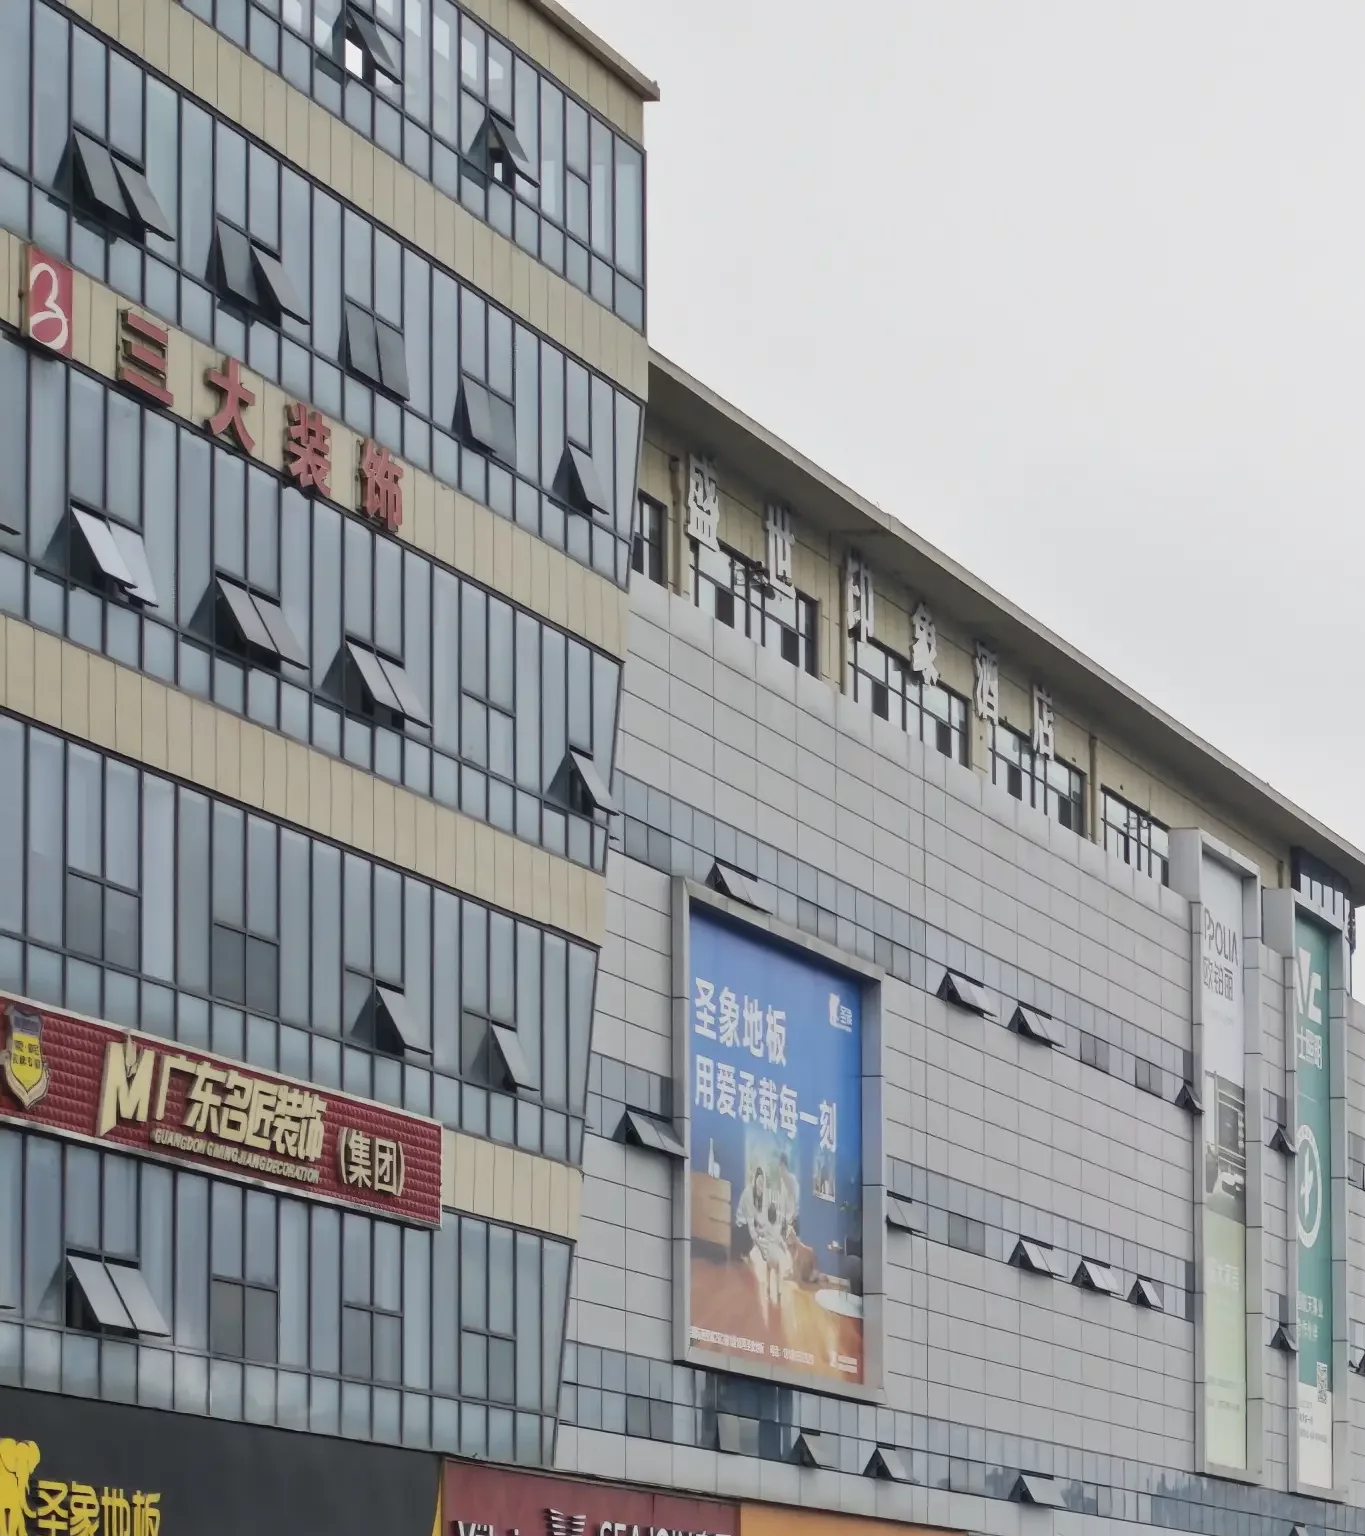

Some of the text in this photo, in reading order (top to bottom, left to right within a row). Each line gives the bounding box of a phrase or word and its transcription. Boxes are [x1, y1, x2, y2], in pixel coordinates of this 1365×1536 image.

[118, 308, 404, 532] 三大装饰
[687, 452, 1055, 761] 盛世印象酒店
[695, 976, 787, 1067] 圣象地板
[156, 1054, 327, 1162] 广东名匠装饰
[339, 1126, 405, 1195] (集团)
[695, 1054, 837, 1153] 用爱承载每一刻
